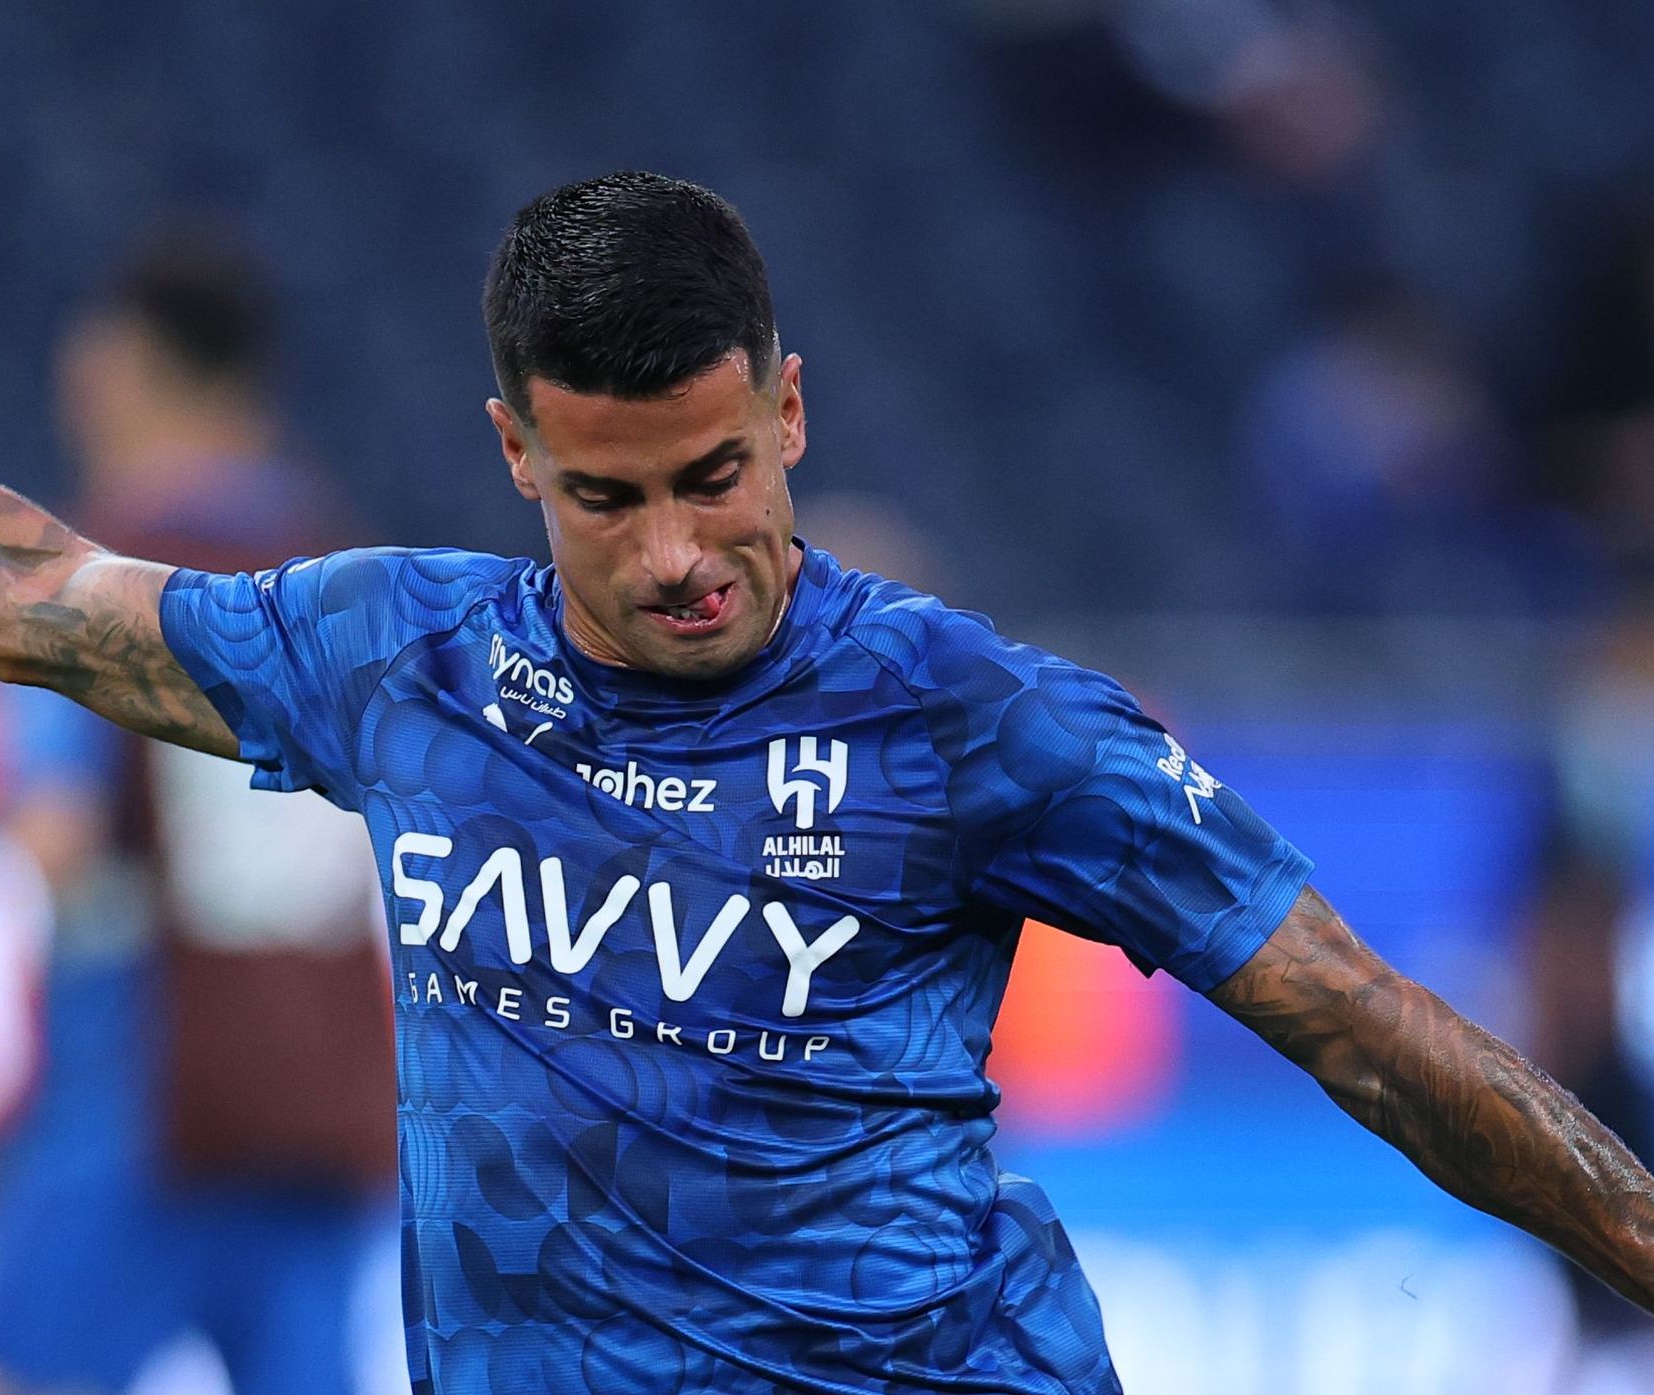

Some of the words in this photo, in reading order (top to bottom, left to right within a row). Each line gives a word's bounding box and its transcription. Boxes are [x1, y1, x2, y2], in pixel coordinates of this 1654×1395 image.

[762, 836, 845, 856] ALHILAL
[765, 857, 840, 880] الهلال
[392, 831, 861, 1018] SAVVY
[409, 972, 571, 1029] GAMES
[609, 1008, 830, 1061] GROUP
